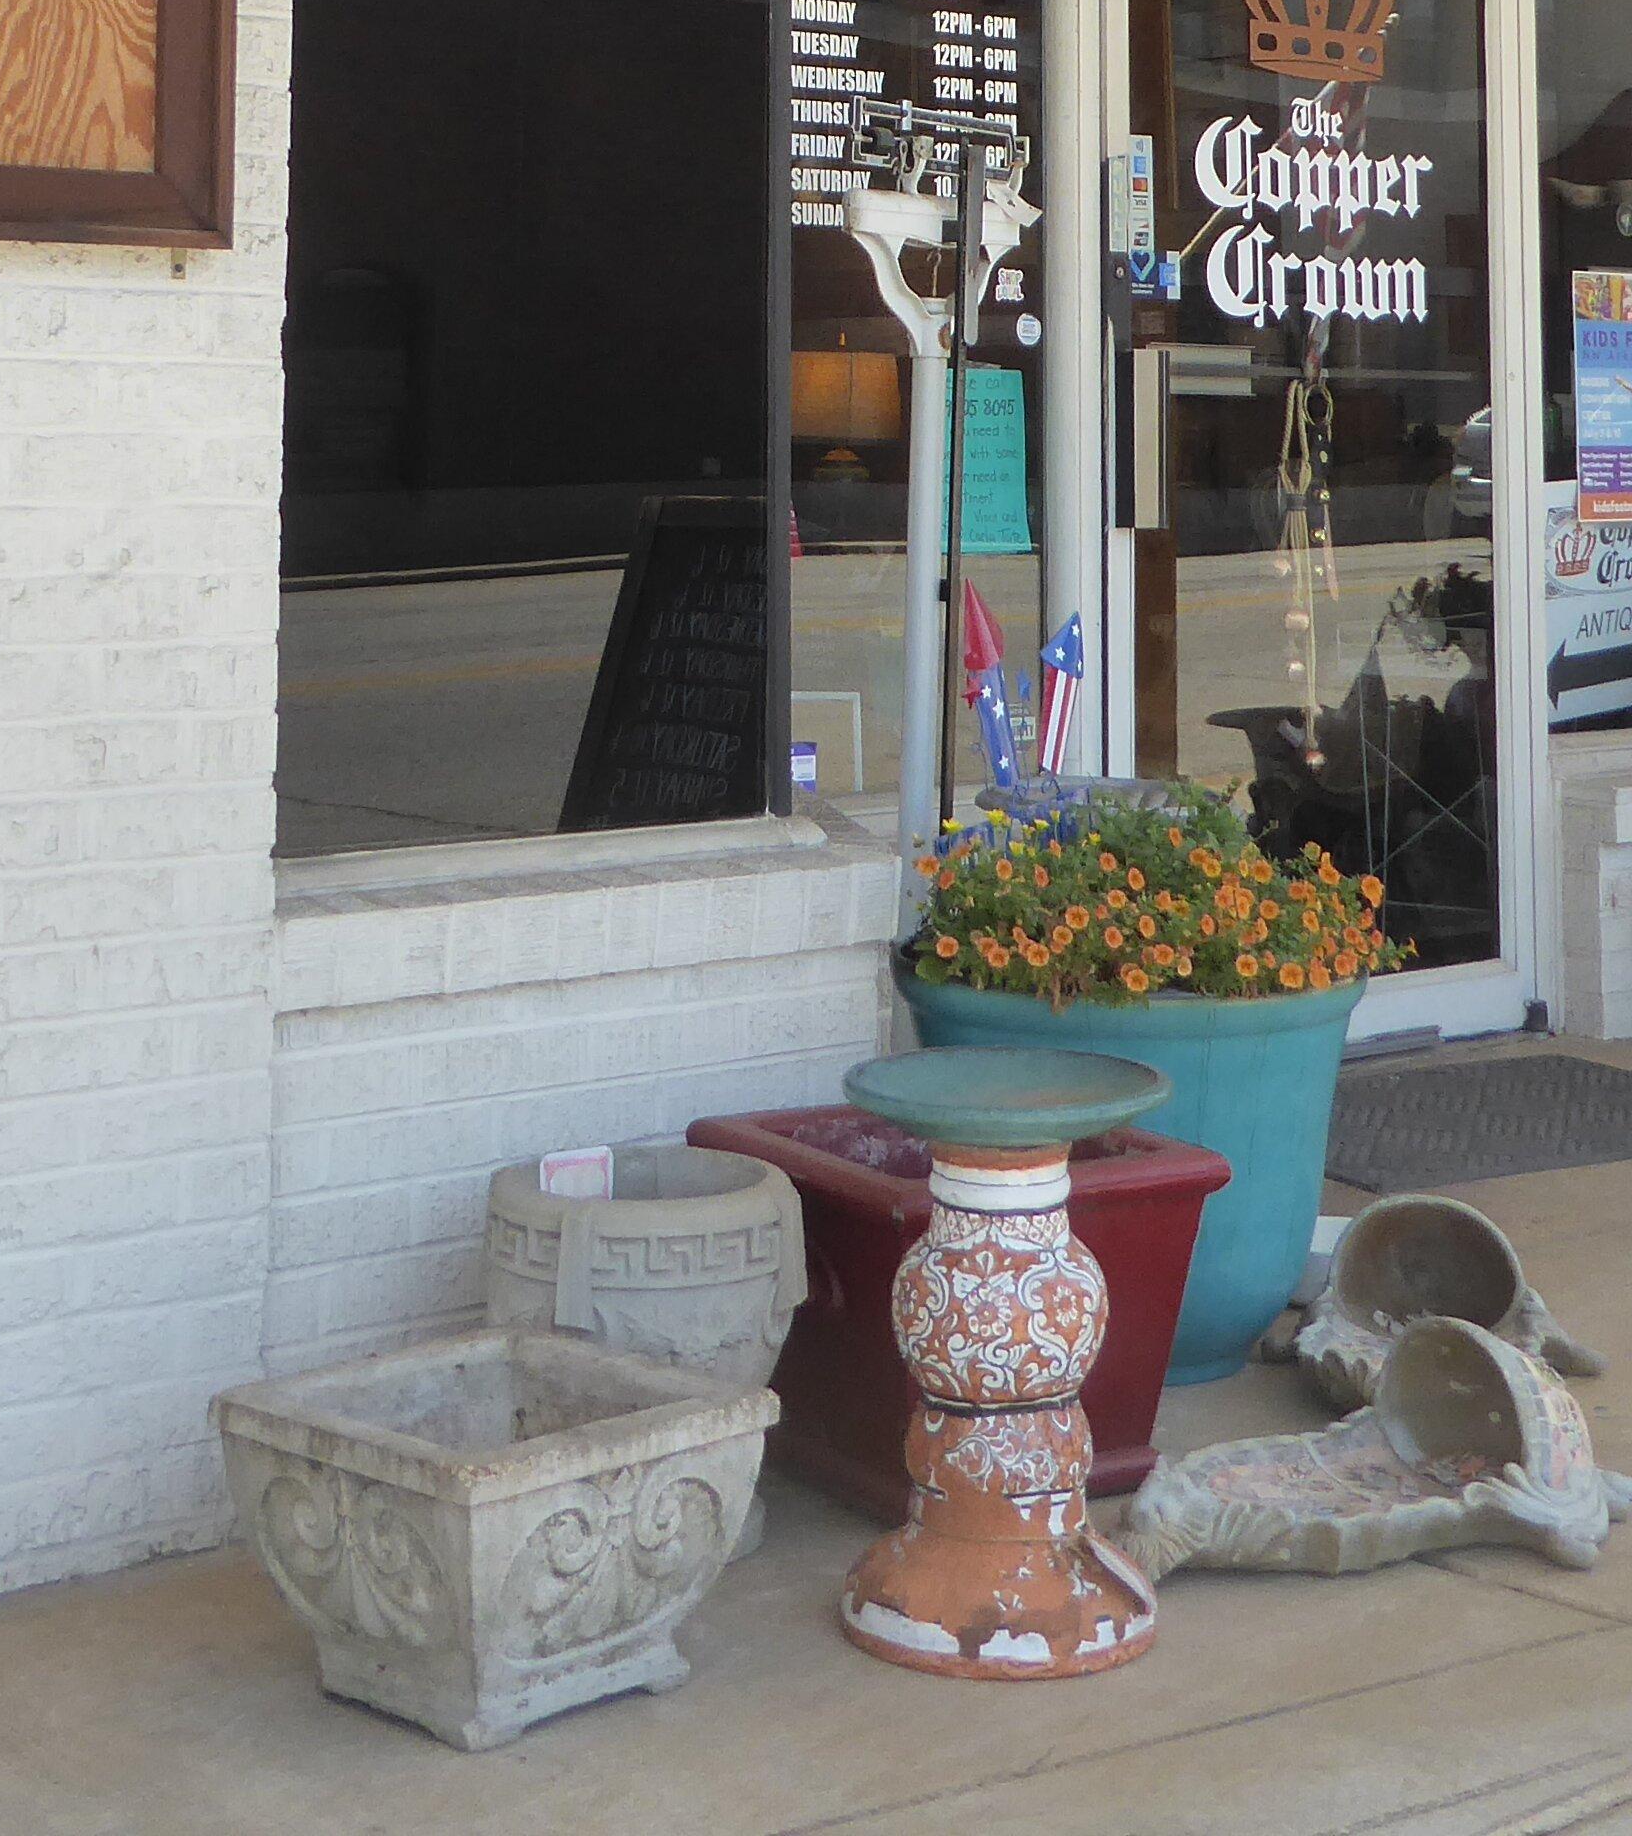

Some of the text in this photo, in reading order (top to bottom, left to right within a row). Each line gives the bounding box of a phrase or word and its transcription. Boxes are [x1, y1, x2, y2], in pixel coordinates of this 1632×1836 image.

[932, 10, 973, 36] 12PM
[983, 16, 1017, 39] 6PM
[791, 31, 860, 59] TUESDAY
[933, 43, 973, 68] 12PM
[984, 48, 1017, 71] 6PM
[791, 64, 885, 94] WEDNESDAY
[933, 75, 973, 101] 12PM
[984, 81, 1018, 104] 6PM
[1290, 97, 1343, 147] The
[791, 133, 846, 160] FRIDAY
[791, 167, 871, 193] SATURDAY
[1194, 114, 1433, 234] Copper
[791, 202, 844, 228] SUNDA
[1206, 224, 1430, 329] Crown
[1582, 330, 1618, 348] KIDS
[983, 398, 1016, 417] 8095
